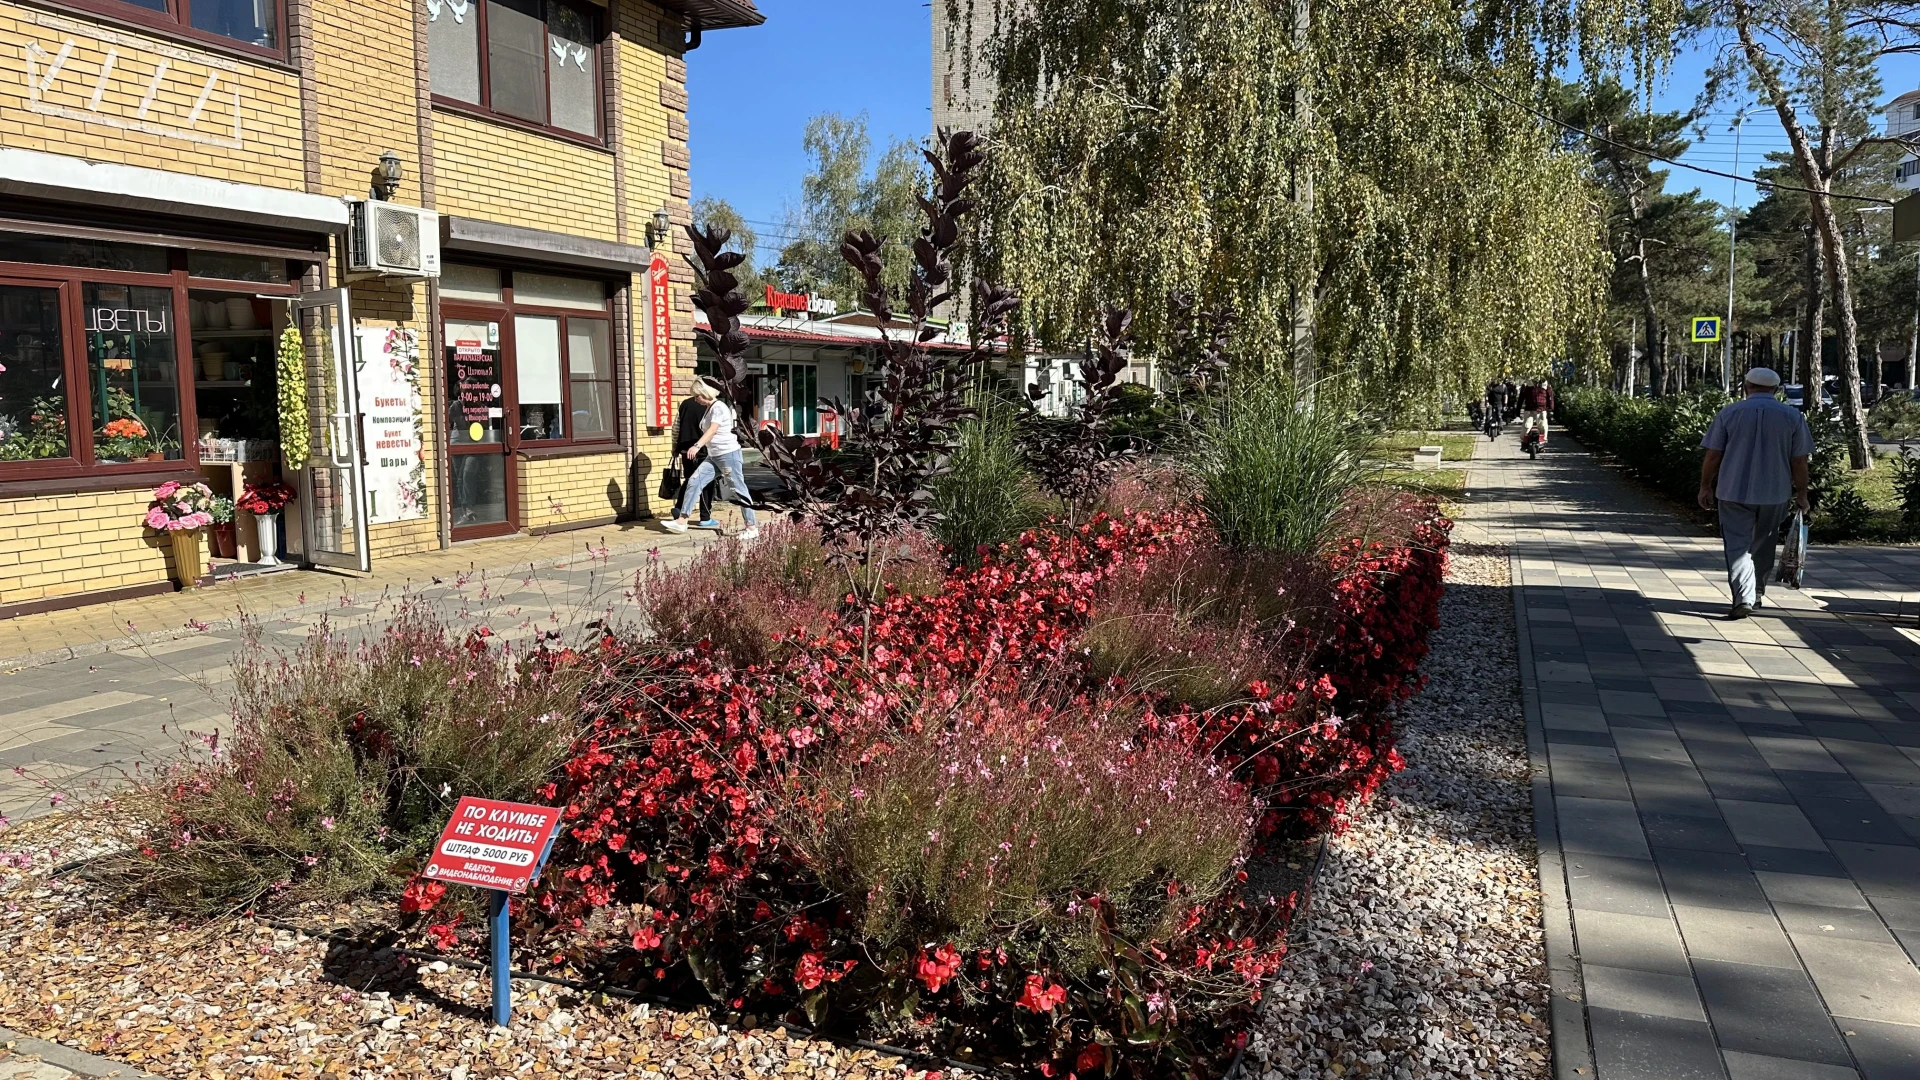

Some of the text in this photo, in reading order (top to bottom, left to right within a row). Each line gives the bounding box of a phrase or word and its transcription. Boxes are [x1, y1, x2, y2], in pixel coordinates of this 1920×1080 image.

[453, 353, 493, 362] ПАРИКМАХЕРСКАЯ
[654, 285, 669, 425] ПАРИКМАХЕРСКАЯ
[374, 396, 407, 408] Букеты
[372, 416, 411, 424] Композиции
[383, 429, 402, 438] Букет
[375, 438, 411, 449] невесты
[380, 457, 408, 468] Шары
[463, 805, 547, 828] ПО КЛУМБЕ
[454, 822, 540, 845] НЕ ХОДИТЬ!
[446, 842, 529, 863] ШТРАФ 5000 РУБ
[463, 862, 496, 874] ВЕДЕТСЯ
[438, 868, 514, 887] ВИДЕОНАБЛЮДЕНИЕ
